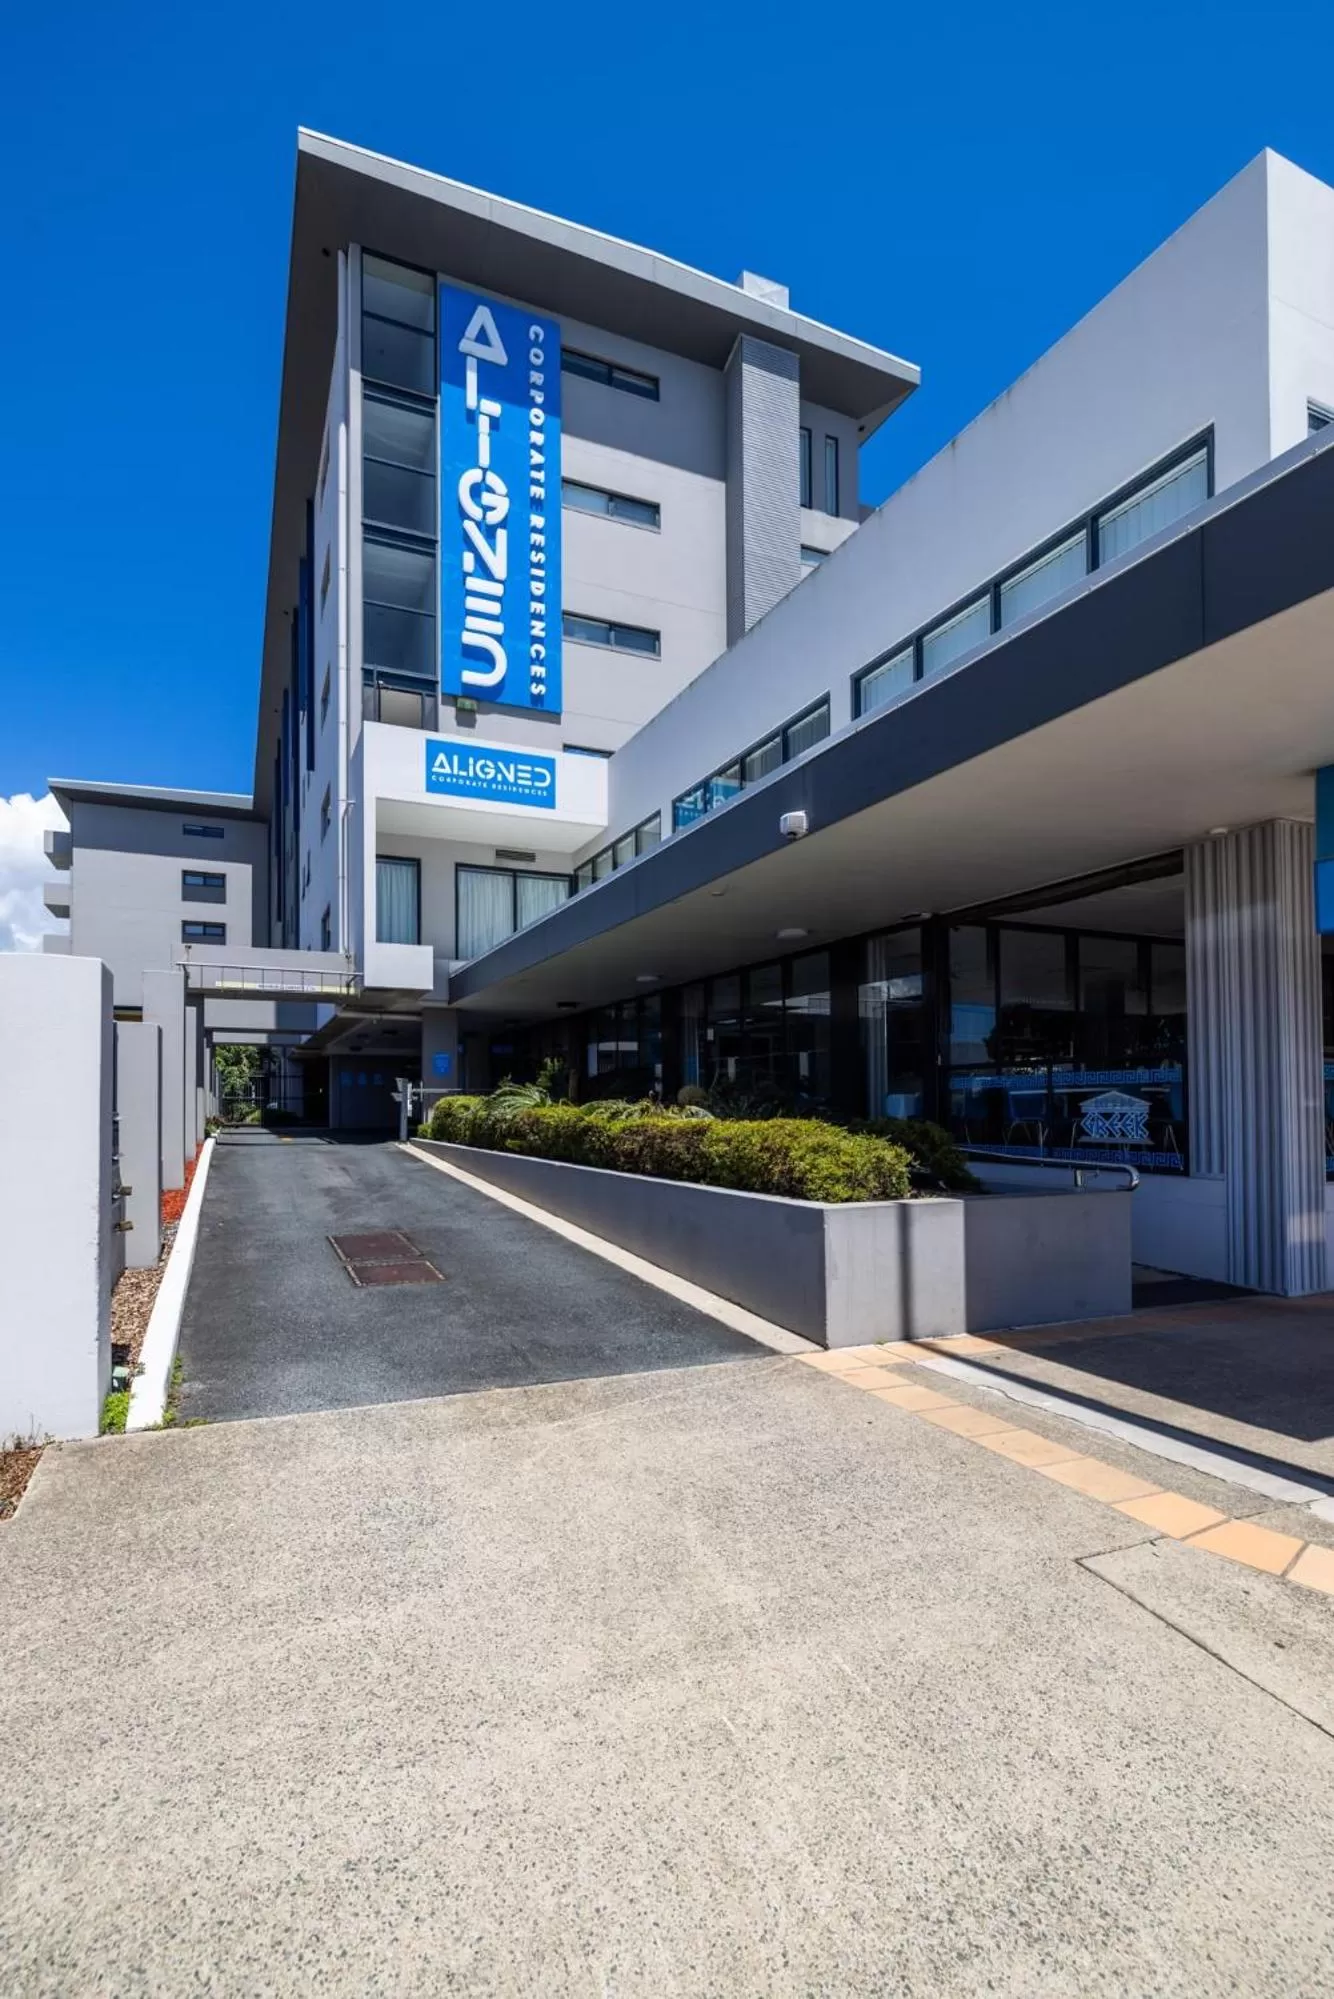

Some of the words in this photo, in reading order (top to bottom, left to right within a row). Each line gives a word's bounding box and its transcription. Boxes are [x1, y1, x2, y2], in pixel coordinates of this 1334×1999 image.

[528, 324, 546, 501] CORPORATE
[458, 304, 509, 688] ALIGNED
[529, 516, 547, 697] RESIDENCES
[431, 752, 552, 788] ALIGNED
[431, 774, 488, 788] CORPORATE
[491, 782, 548, 797] RESIDENCES
[1081, 1111, 1149, 1138] GREEK
